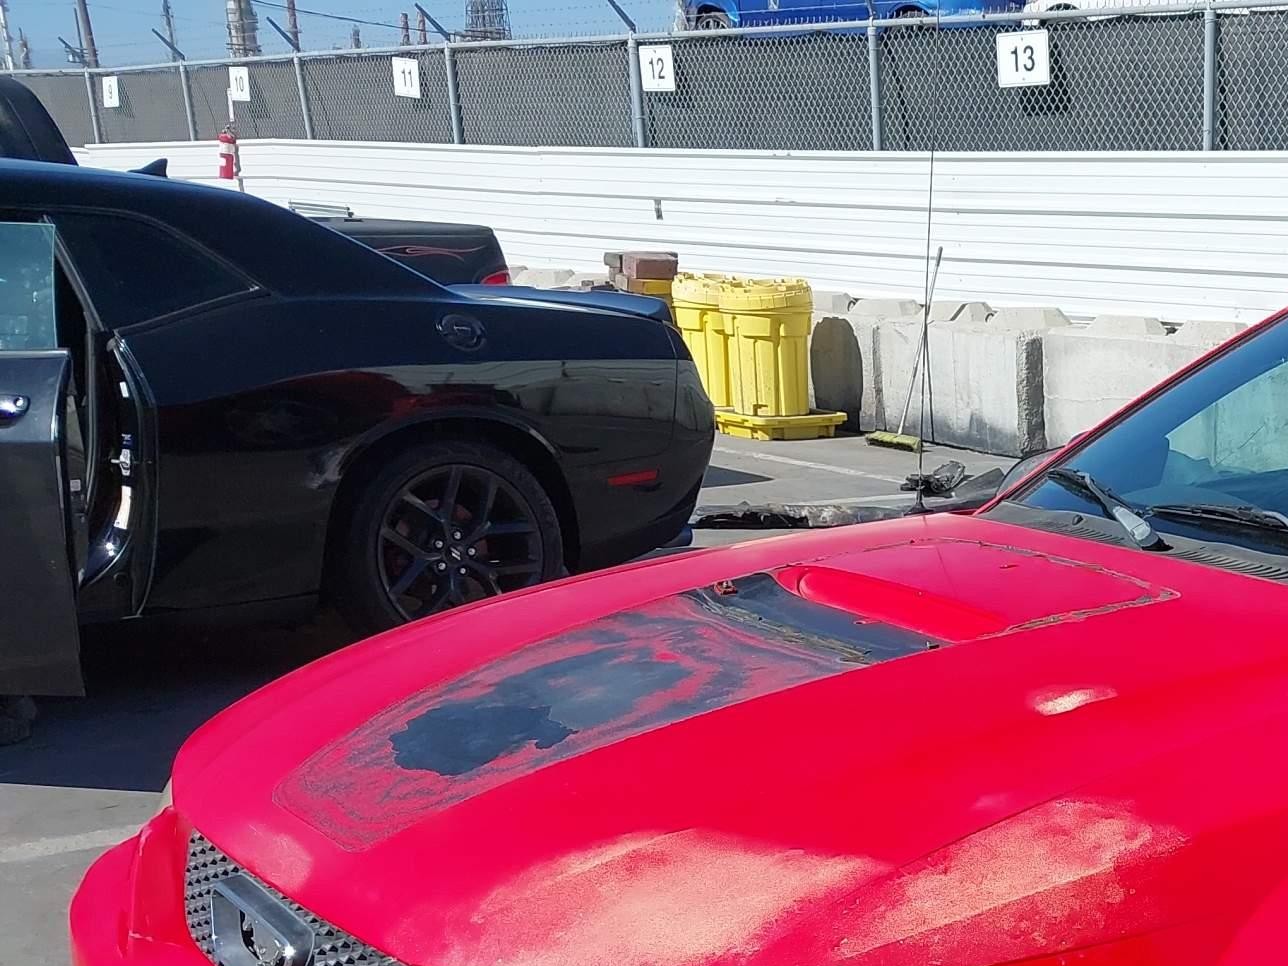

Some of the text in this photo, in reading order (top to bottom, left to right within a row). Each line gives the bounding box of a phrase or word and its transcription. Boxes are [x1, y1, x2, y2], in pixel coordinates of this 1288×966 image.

[648, 57, 666, 80] 12
[1010, 45, 1035, 72] 13
[234, 75, 244, 92] 10
[401, 67, 413, 88] 11
